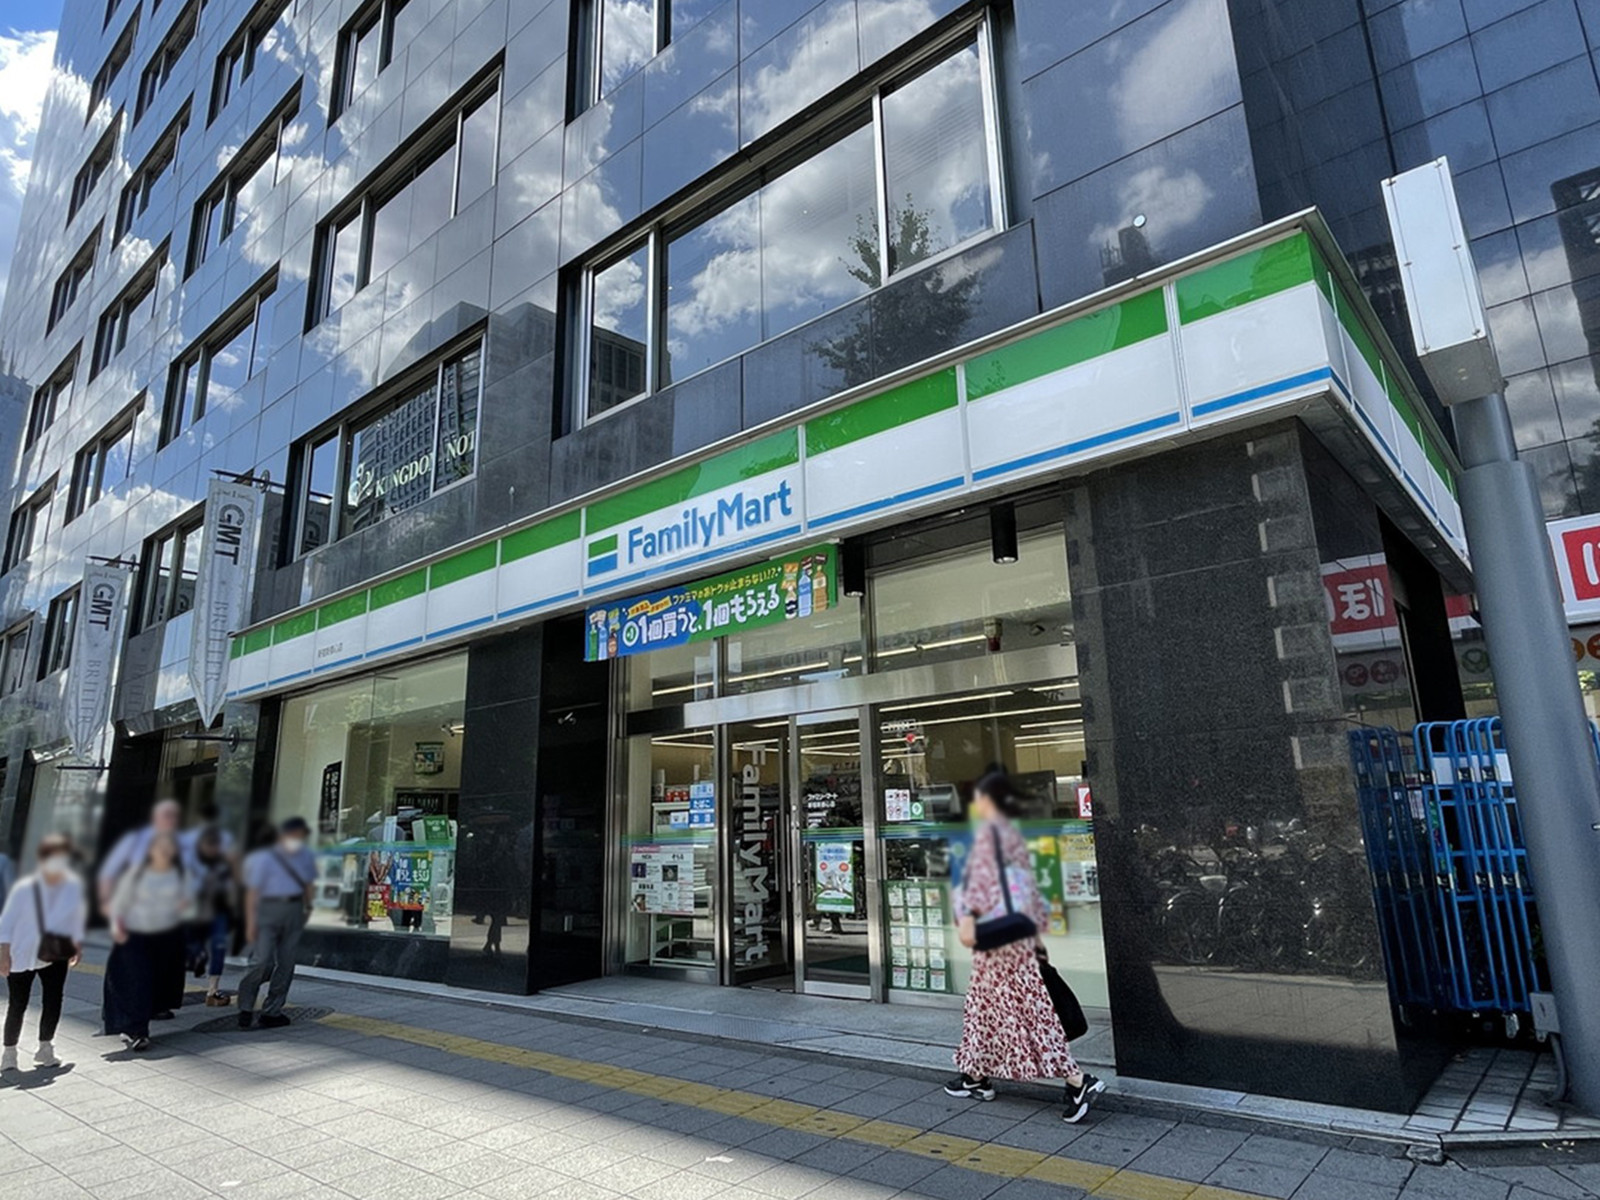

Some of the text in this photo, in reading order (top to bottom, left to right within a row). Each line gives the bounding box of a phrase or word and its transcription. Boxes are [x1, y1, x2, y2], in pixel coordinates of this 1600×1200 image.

[214, 504, 246, 565] GMT
[627, 480, 792, 564] FamilyMart
[89, 583, 115, 631] GMT
[740, 744, 770, 962] FamilyMart
